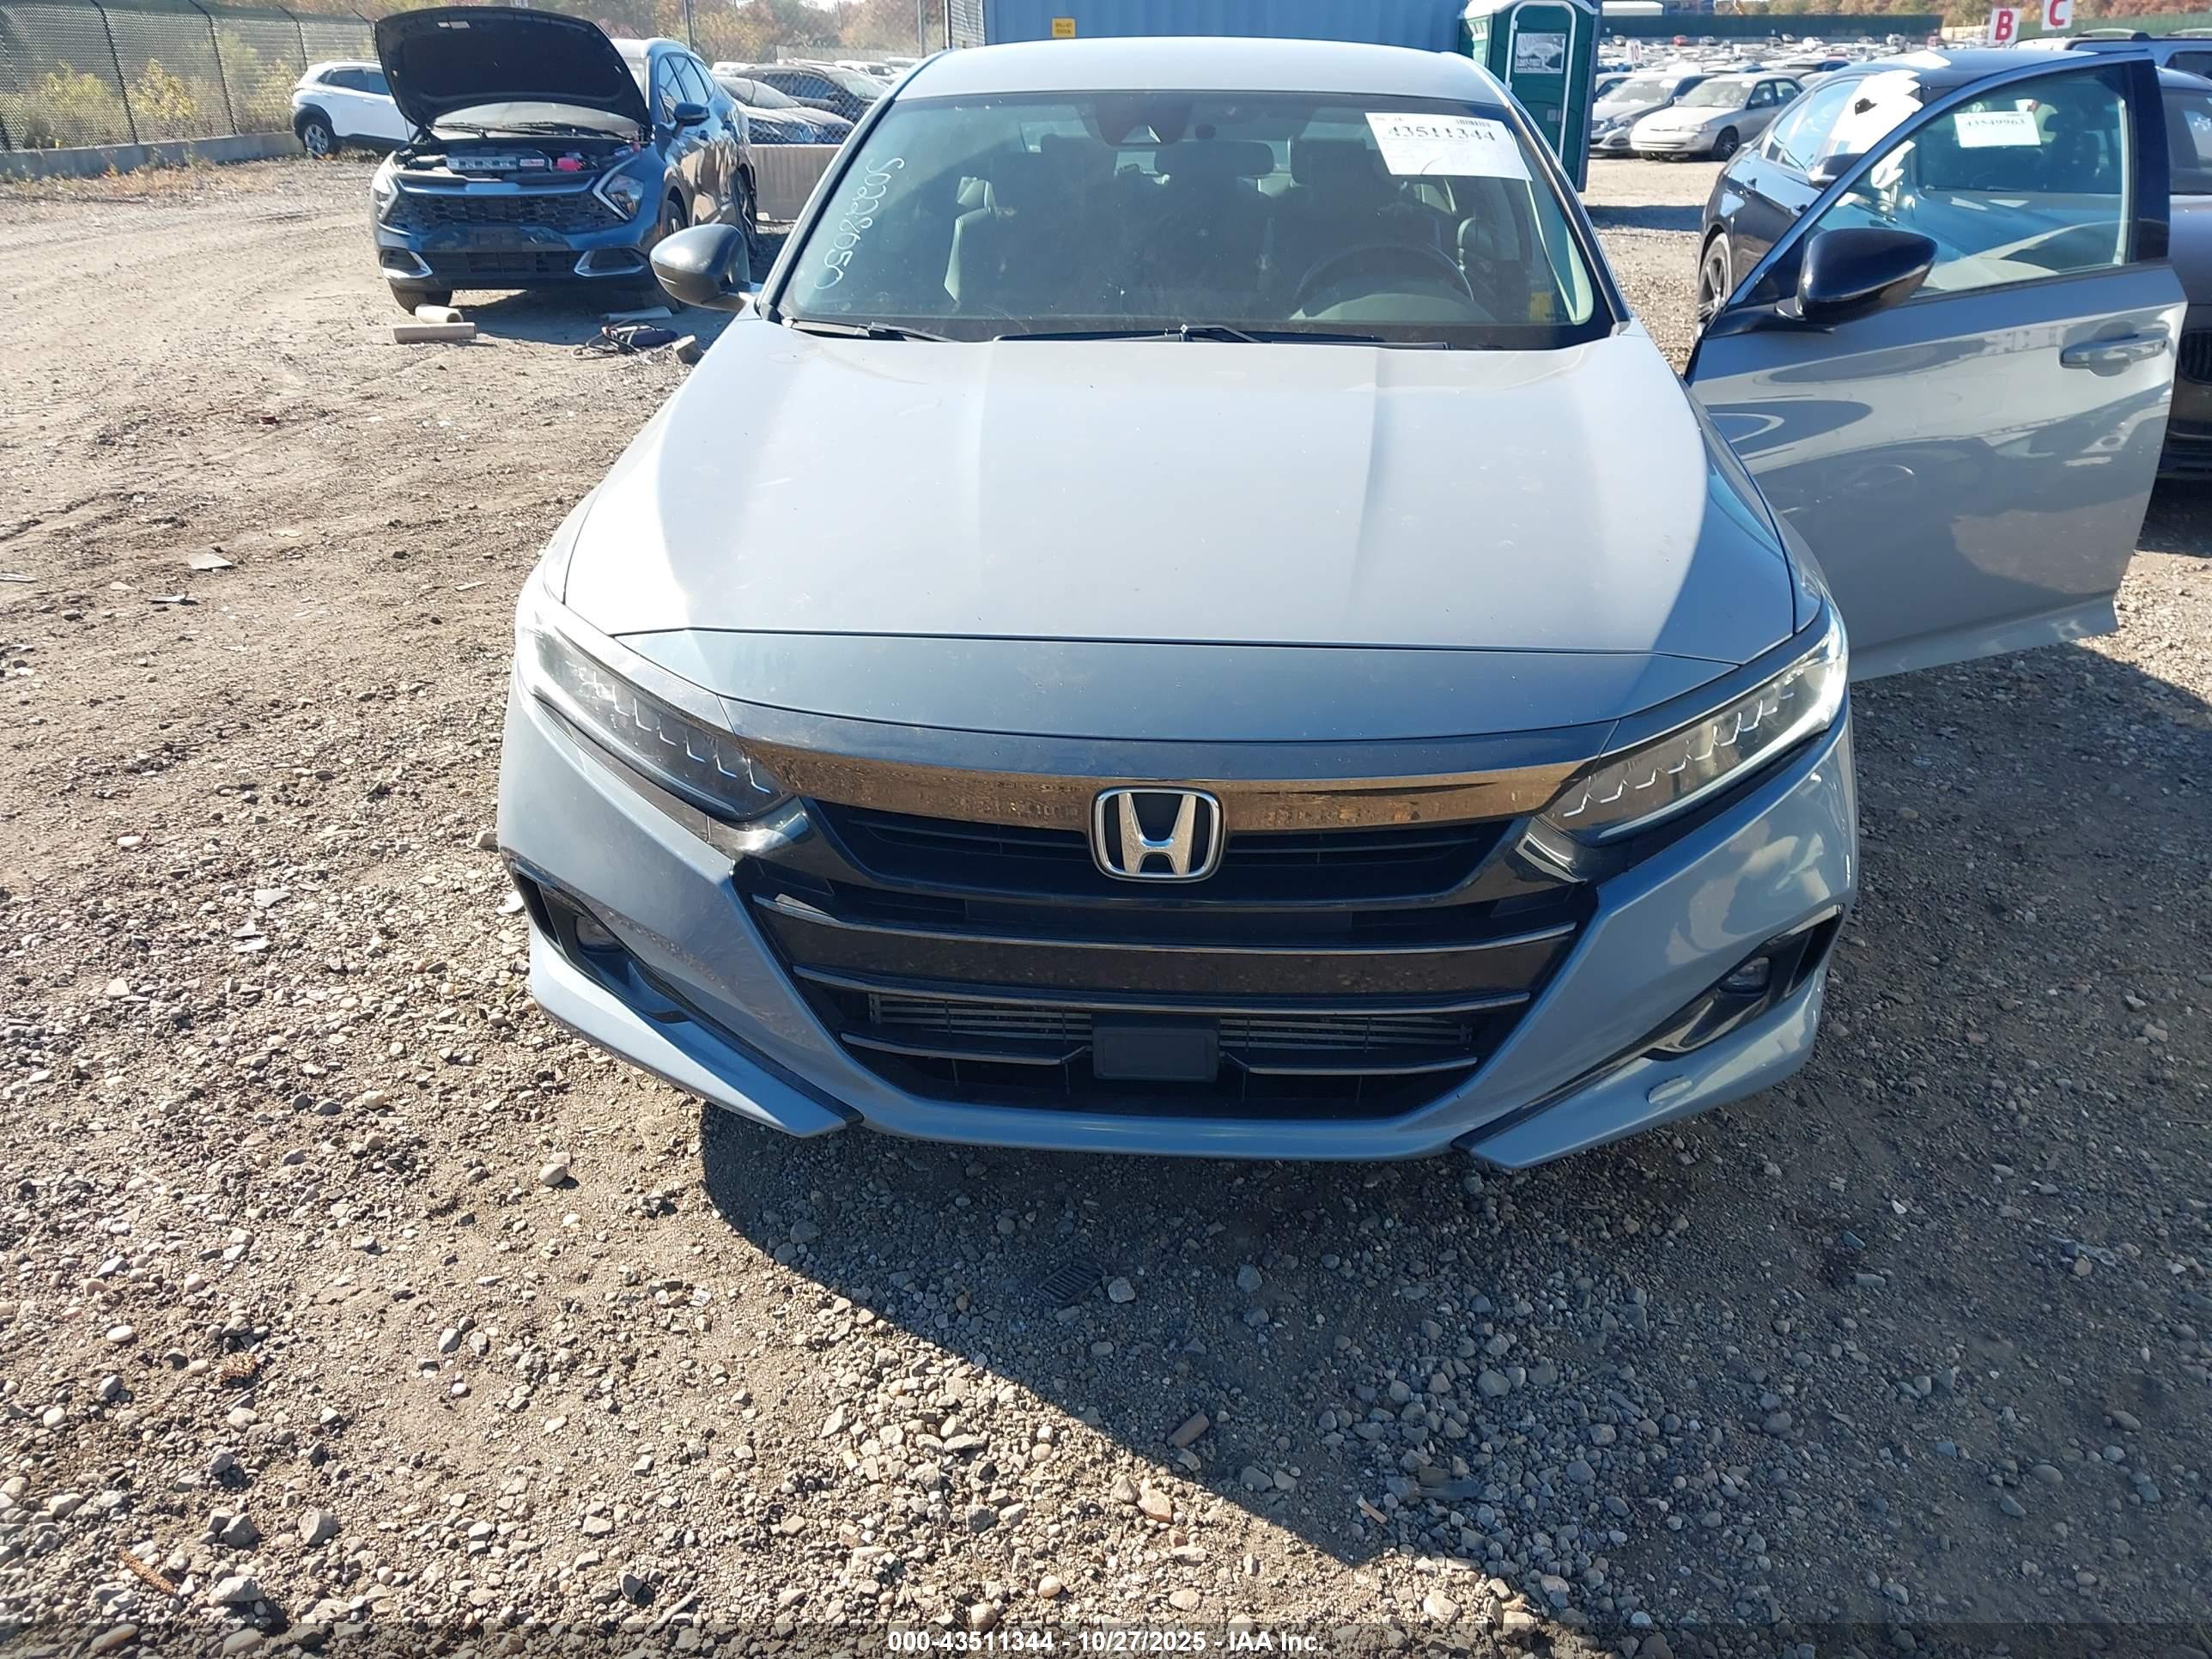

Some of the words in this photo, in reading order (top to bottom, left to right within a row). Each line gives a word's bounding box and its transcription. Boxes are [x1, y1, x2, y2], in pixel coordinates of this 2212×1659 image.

[1995, 9, 2014, 41] B
[2049, 0, 2068, 27] C
[1389, 125, 1496, 142] 43511344
